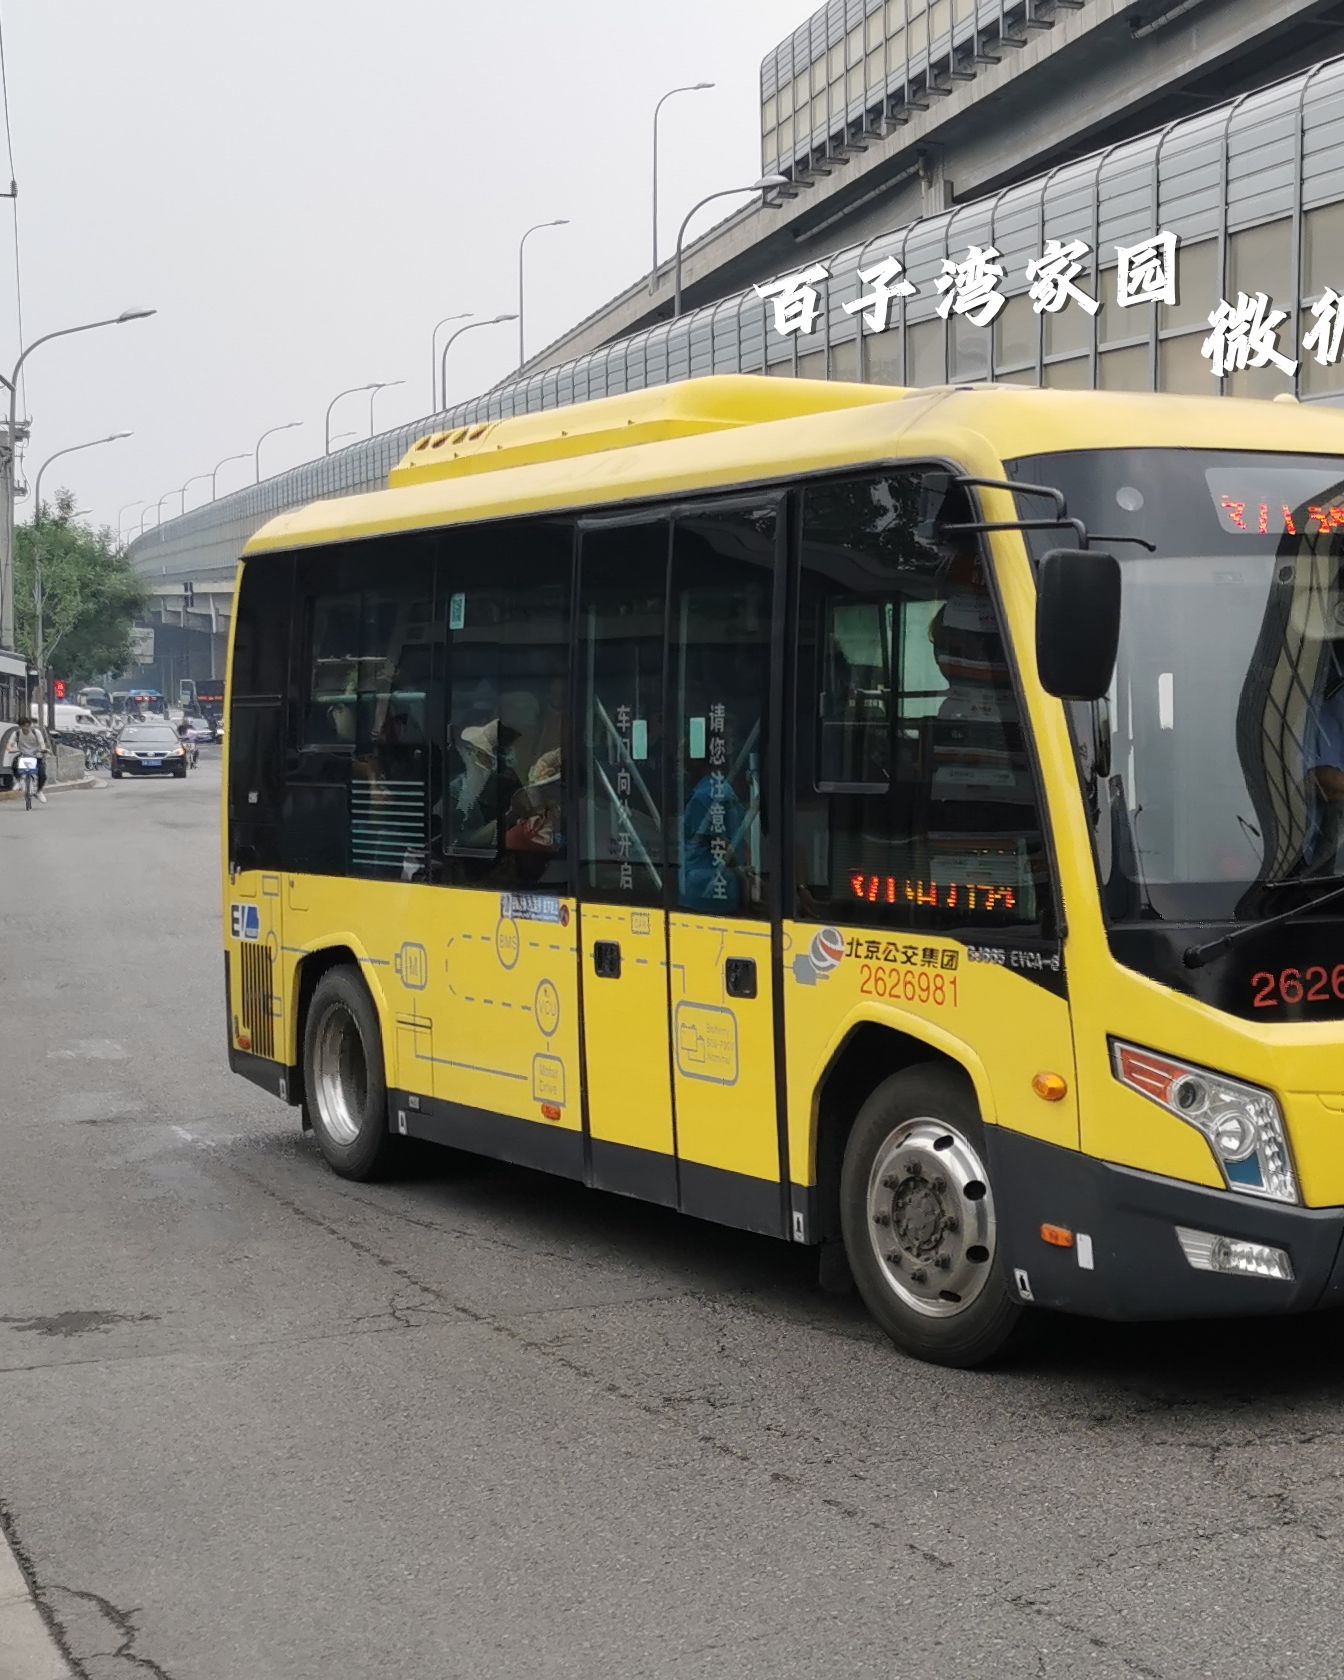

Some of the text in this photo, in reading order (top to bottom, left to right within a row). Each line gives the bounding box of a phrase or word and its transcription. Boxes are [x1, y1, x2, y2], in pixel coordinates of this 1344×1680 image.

[708, 702, 728, 900] 请您注意安全
[845, 936, 960, 971] 北京公交集团
[860, 963, 959, 1007] 2626981
